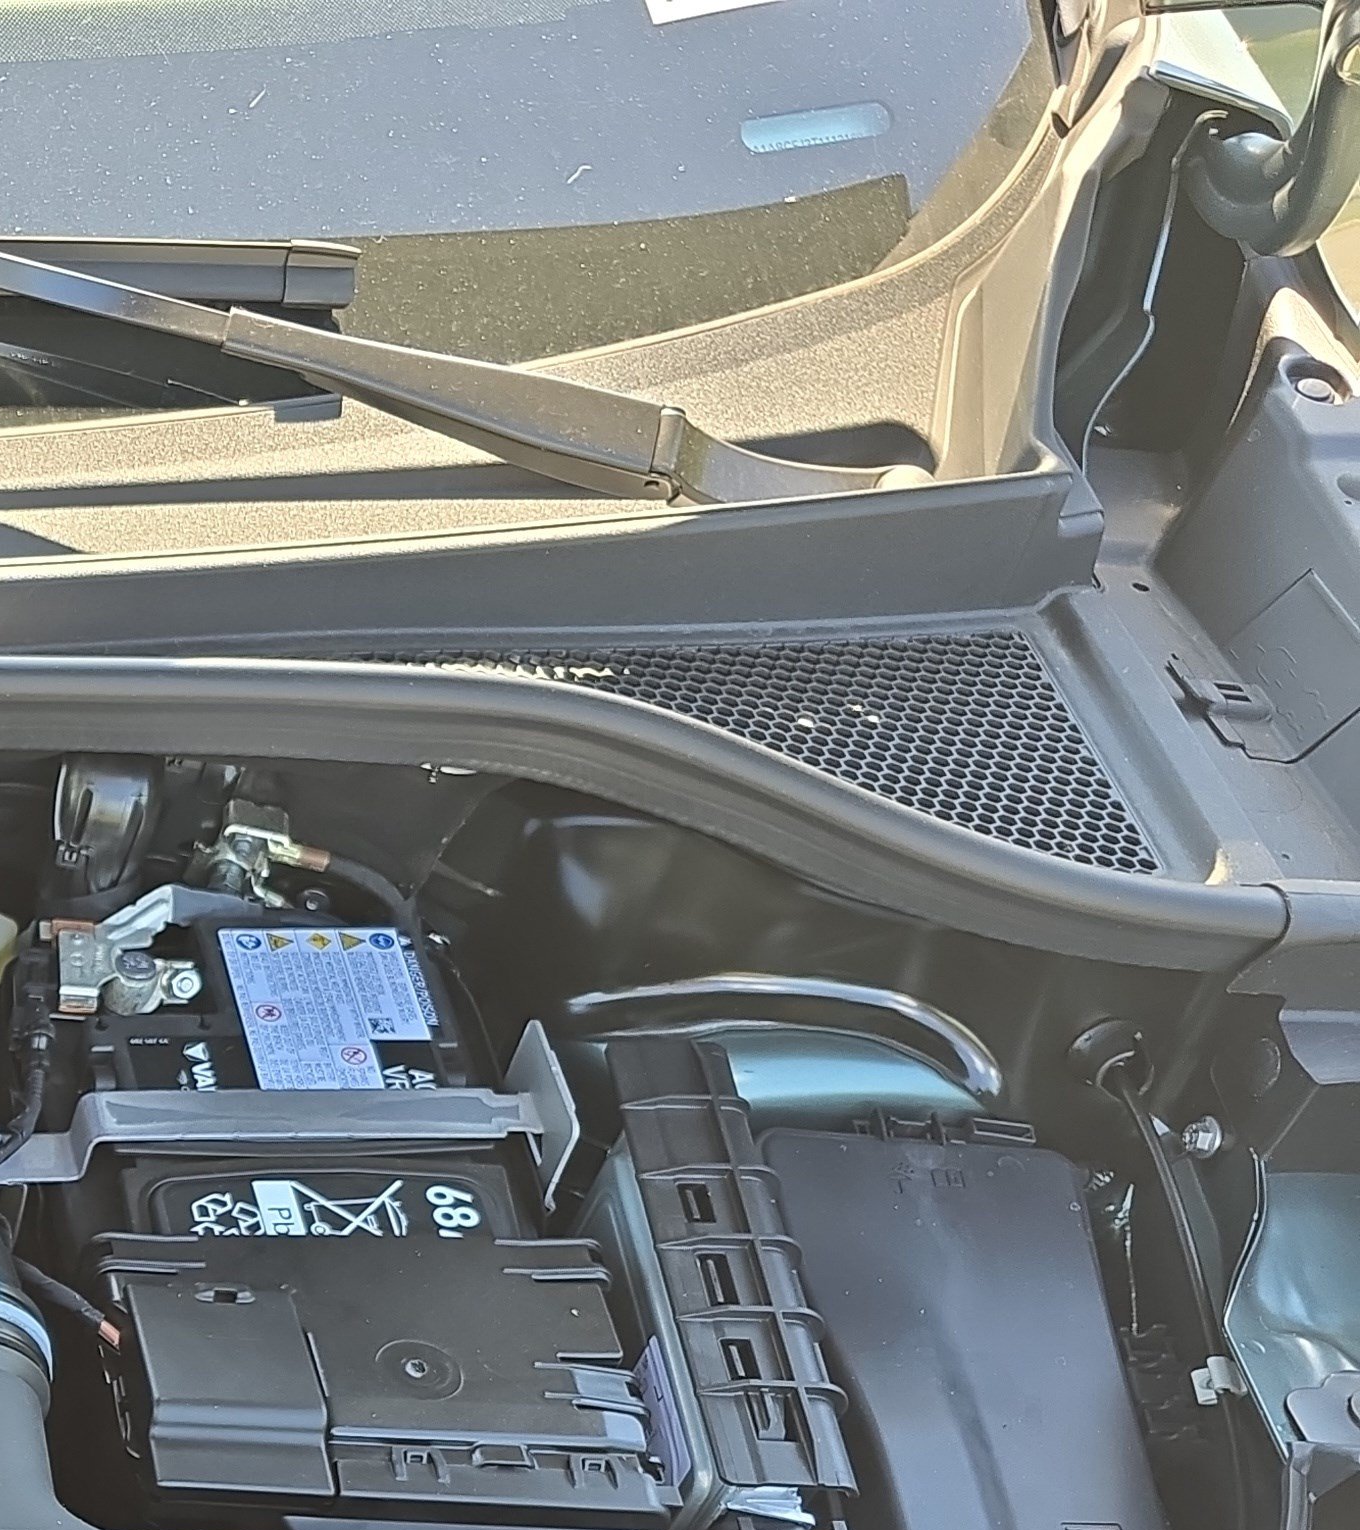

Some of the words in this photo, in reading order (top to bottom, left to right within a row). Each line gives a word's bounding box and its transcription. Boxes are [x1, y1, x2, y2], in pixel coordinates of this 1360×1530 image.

[402, 950, 439, 1027] DANGER/POISON
[191, 1061, 218, 1092] VA
[425, 1185, 481, 1239] 68
